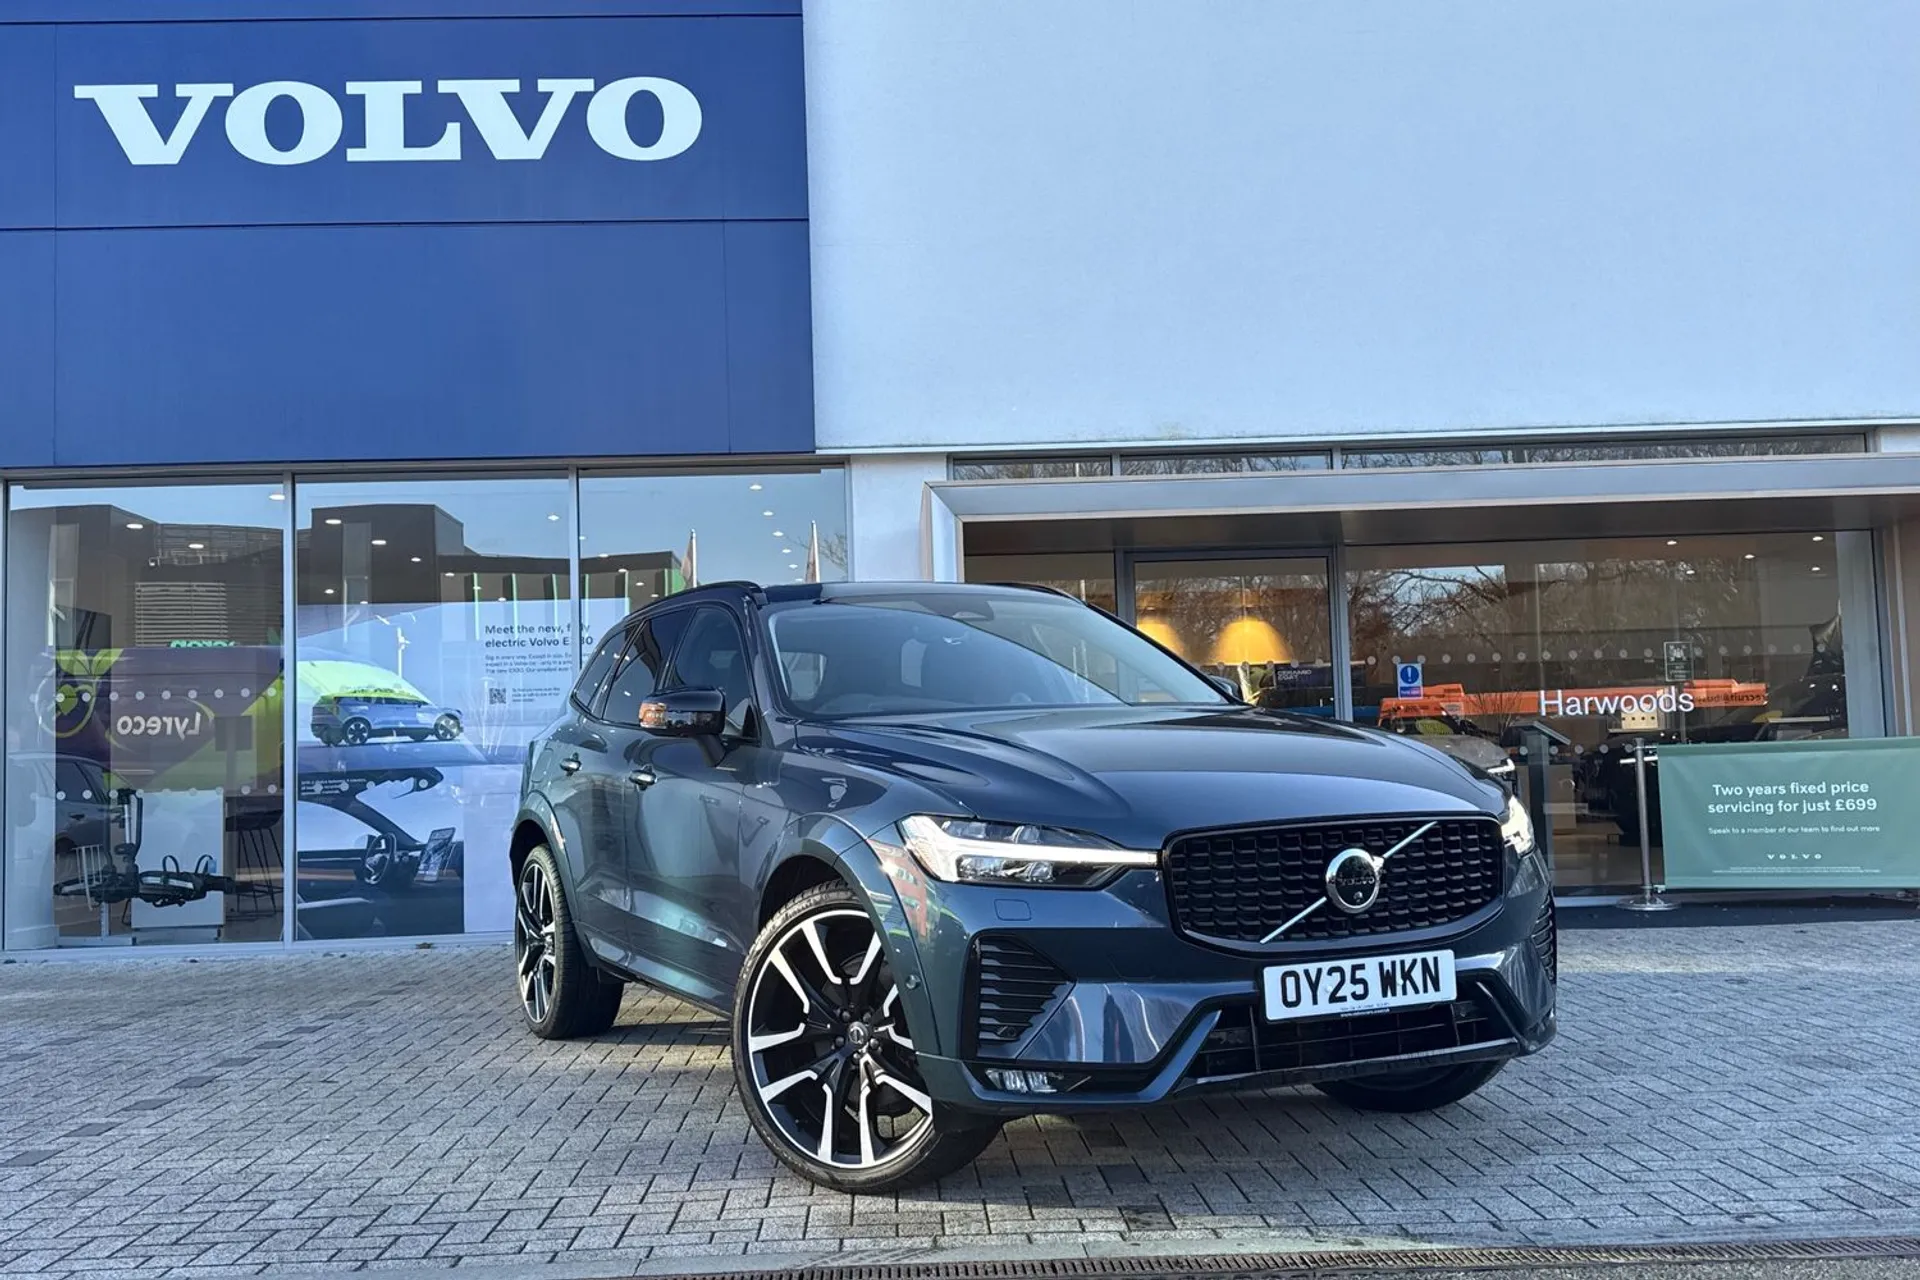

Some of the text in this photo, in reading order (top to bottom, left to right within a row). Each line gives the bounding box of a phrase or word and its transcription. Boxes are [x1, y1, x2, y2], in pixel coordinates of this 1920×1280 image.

[74, 76, 702, 165] VOLVO
[485, 625, 514, 634] Meet
[517, 624, 535, 634] the
[538, 624, 564, 634] new,
[485, 636, 594, 648] electric Volvo E30
[1539, 685, 1695, 716] Harwoods
[1712, 781, 1869, 798] Two years fixed price
[1708, 798, 1878, 815] servicing for just £699
[1708, 827, 1731, 835] Speak
[1747, 826, 1778, 834] member
[1778, 826, 1786, 834] of
[1830, 825, 1845, 833] find
[1280, 956, 1441, 1008] OY25 WKN
